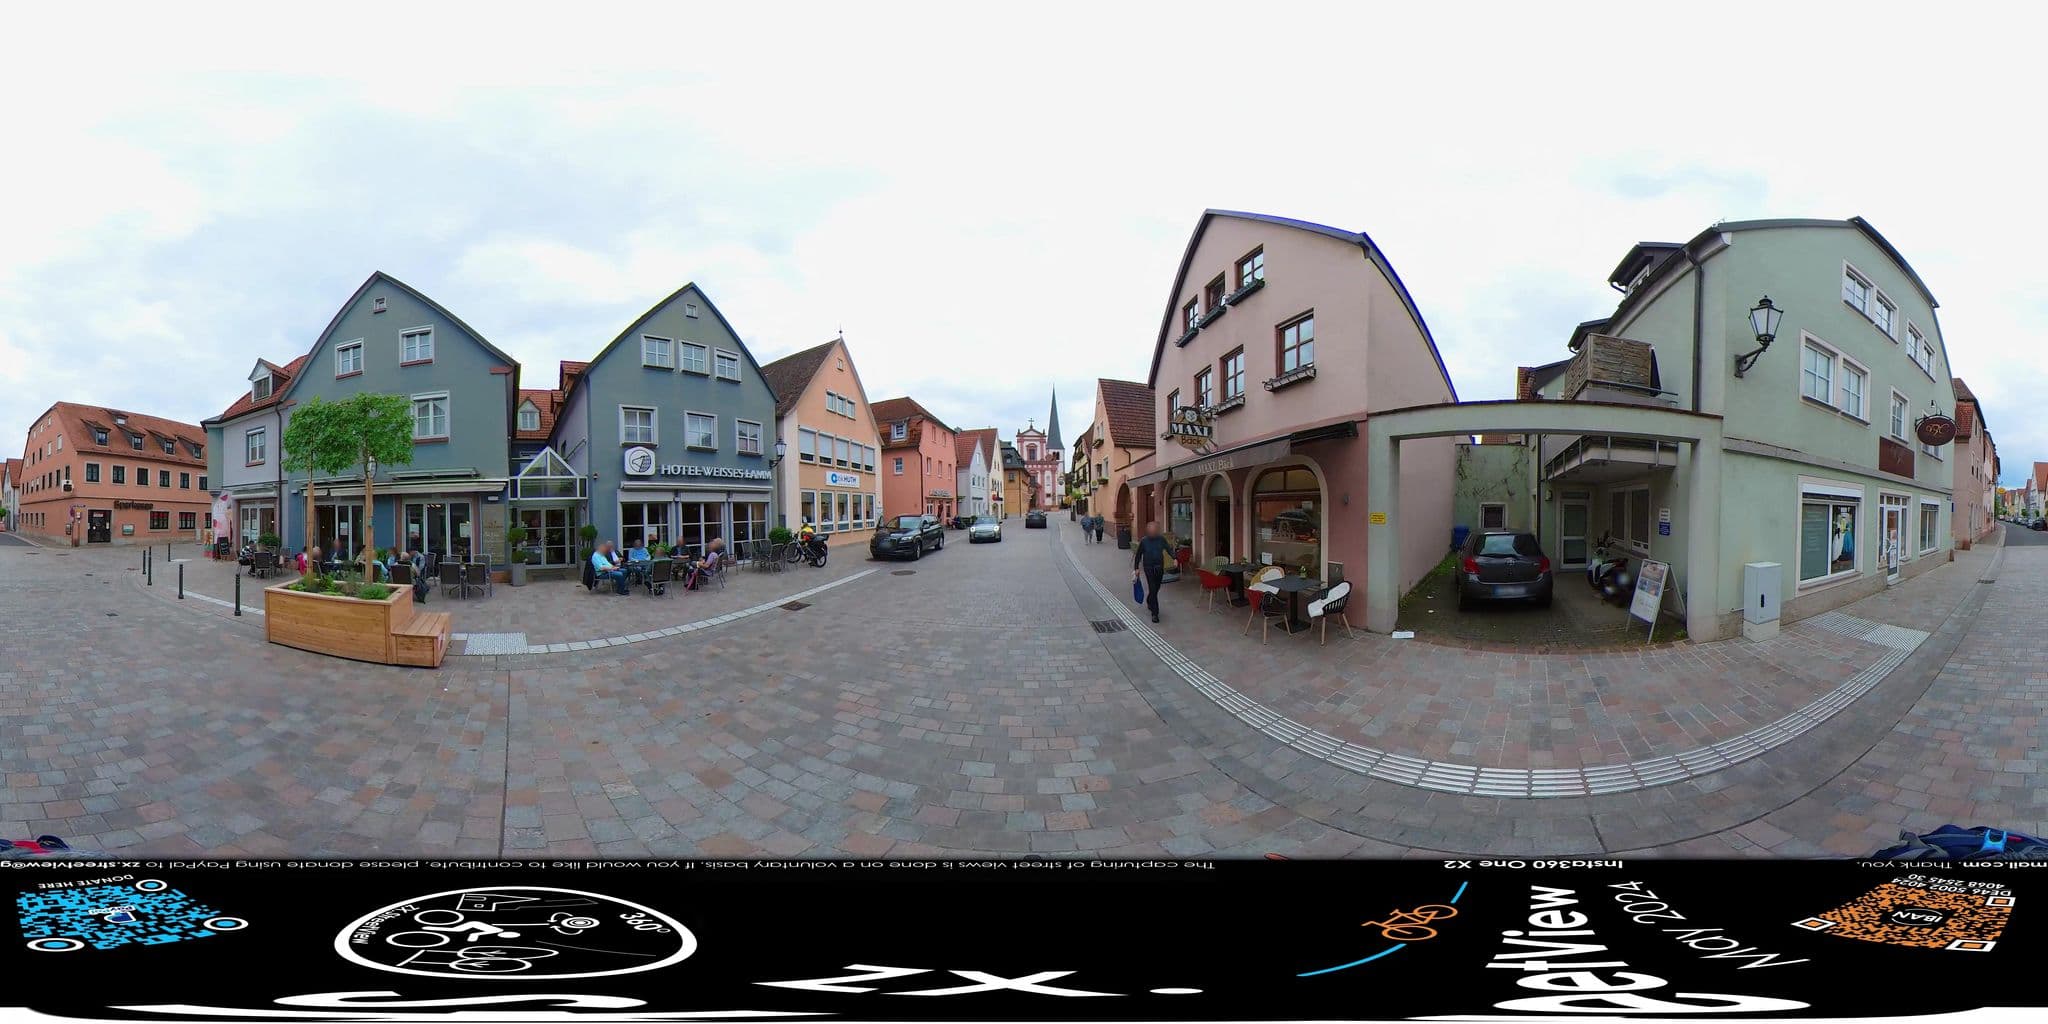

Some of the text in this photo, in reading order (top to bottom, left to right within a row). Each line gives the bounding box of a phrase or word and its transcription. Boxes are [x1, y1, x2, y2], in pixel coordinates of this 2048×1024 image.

[1171, 423, 1209, 437] MAXI
[660, 463, 773, 481] HOTEL WEISSES LAMM
